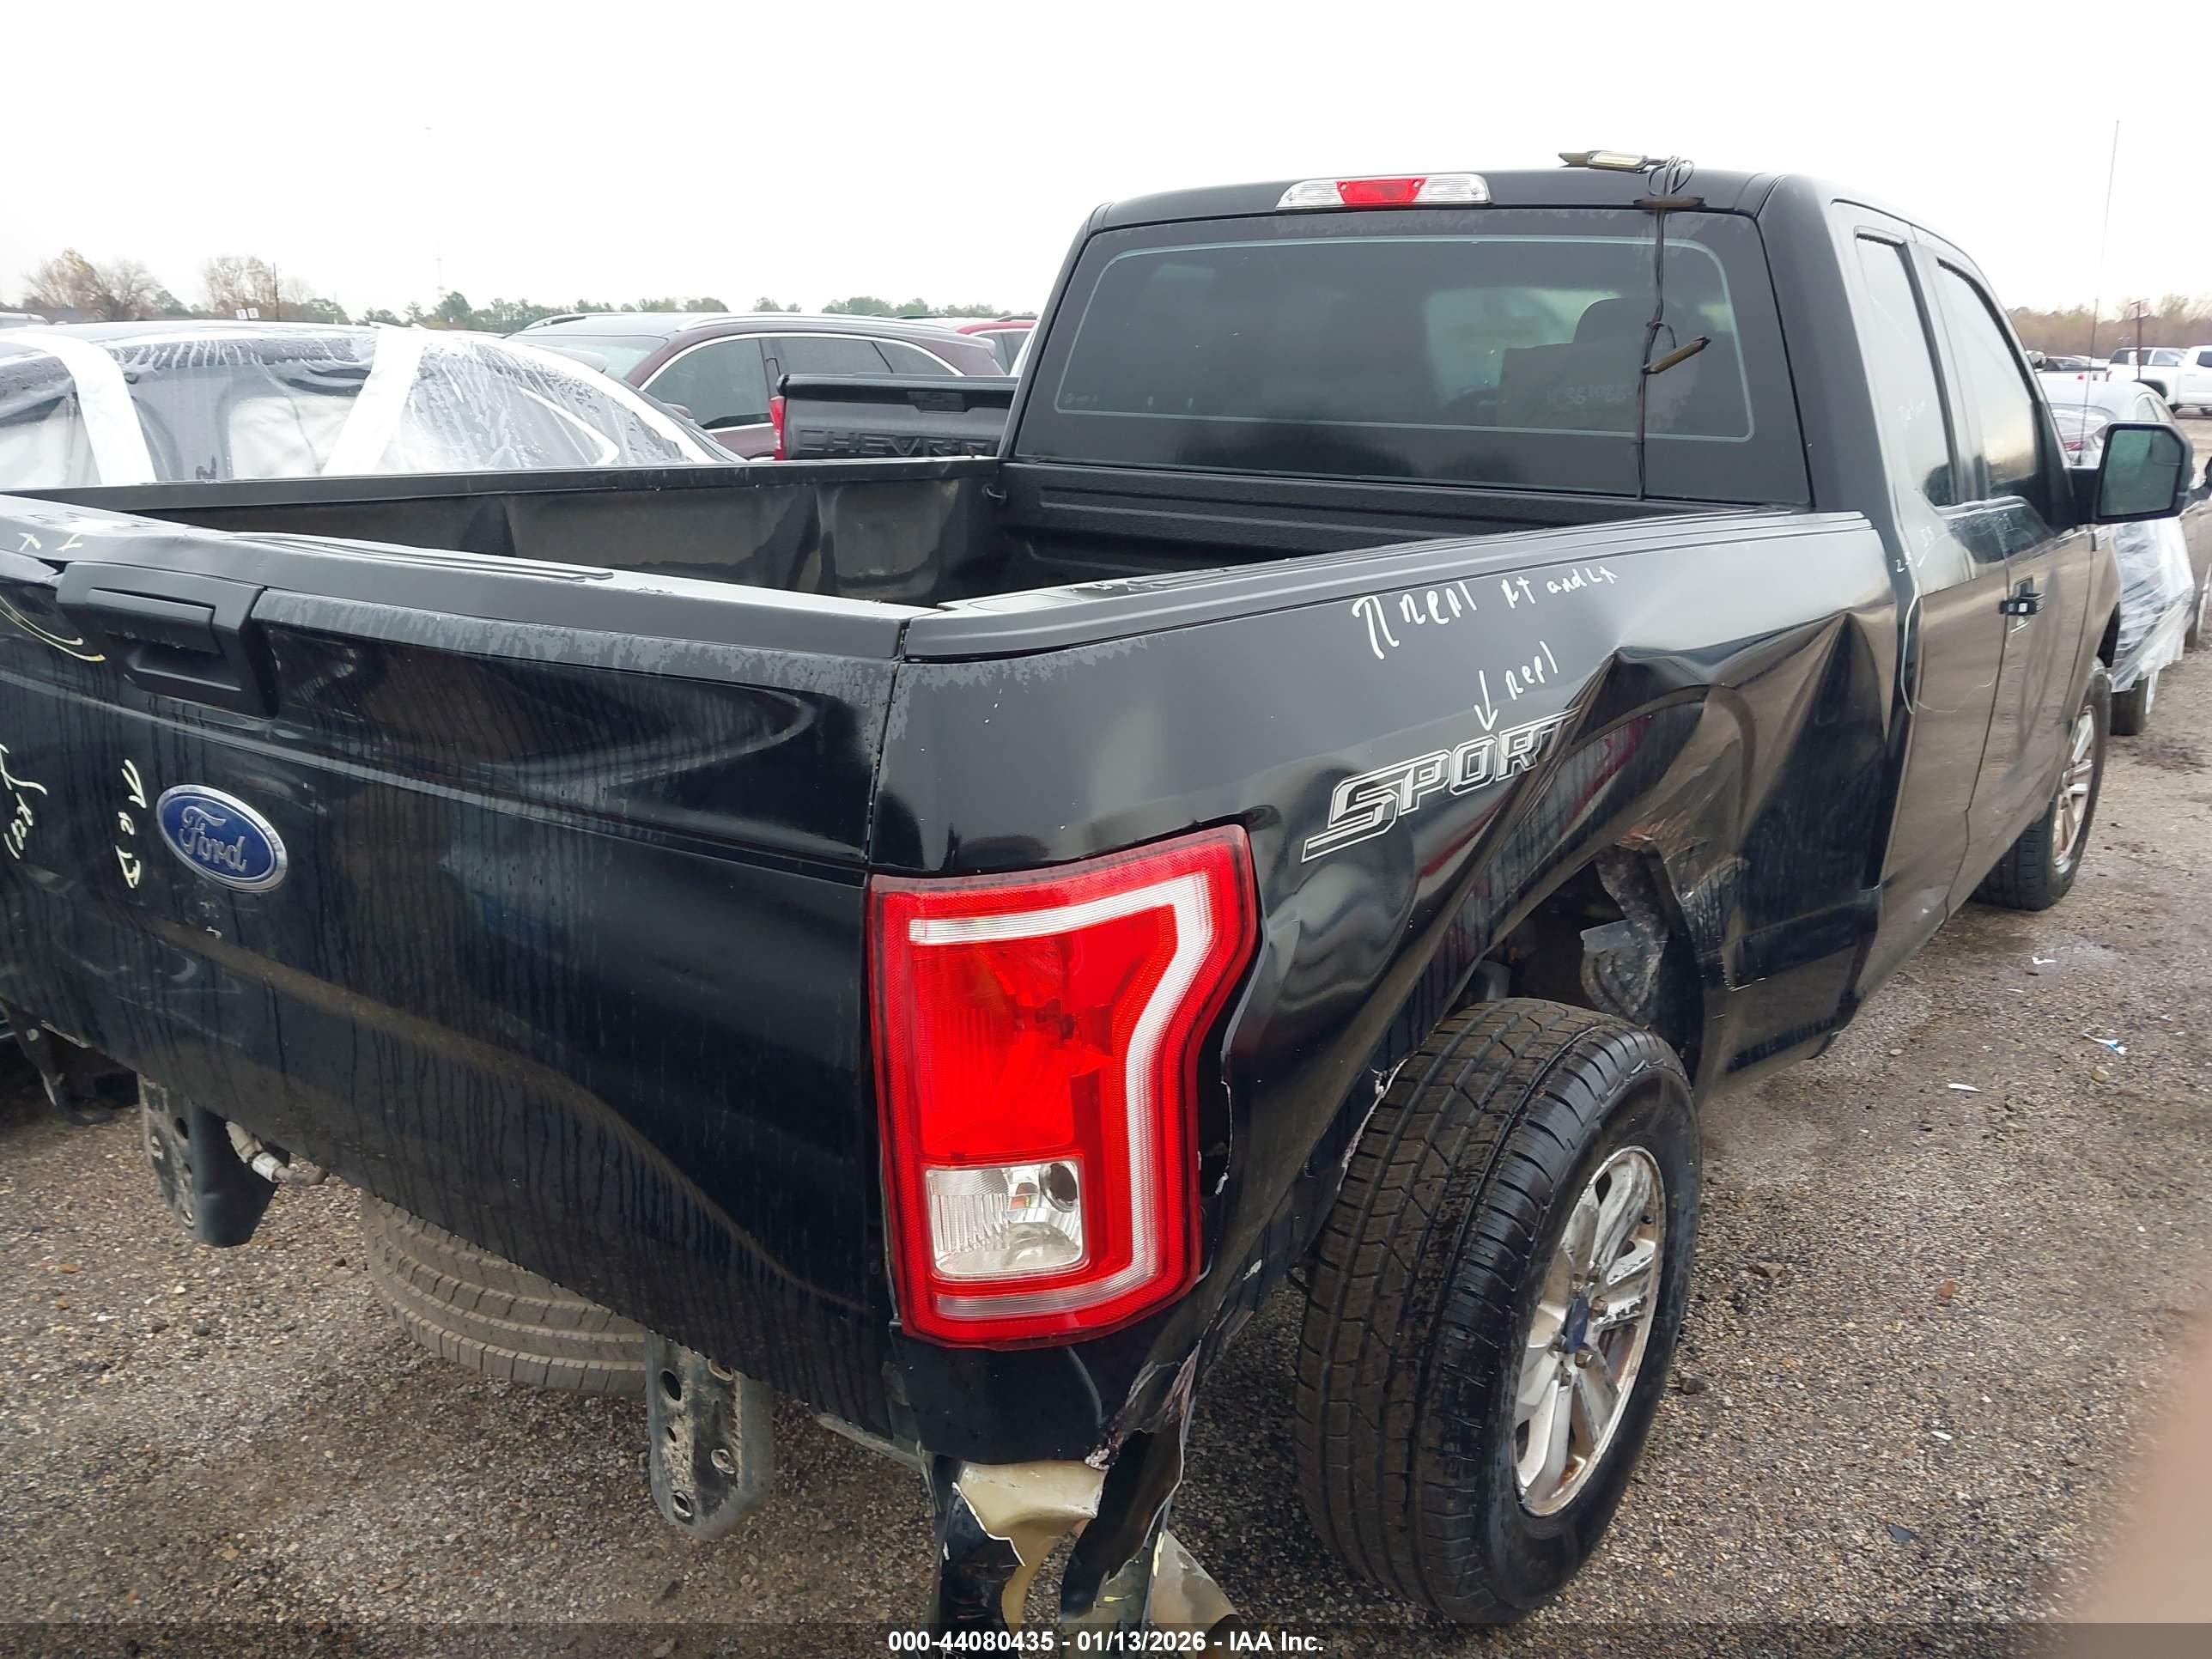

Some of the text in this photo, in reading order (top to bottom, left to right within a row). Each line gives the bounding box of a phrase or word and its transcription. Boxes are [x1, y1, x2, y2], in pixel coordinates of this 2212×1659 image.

[1547, 568, 1587, 594] and
[1300, 704, 1583, 864] SPORT
[178, 805, 248, 872] Ford
